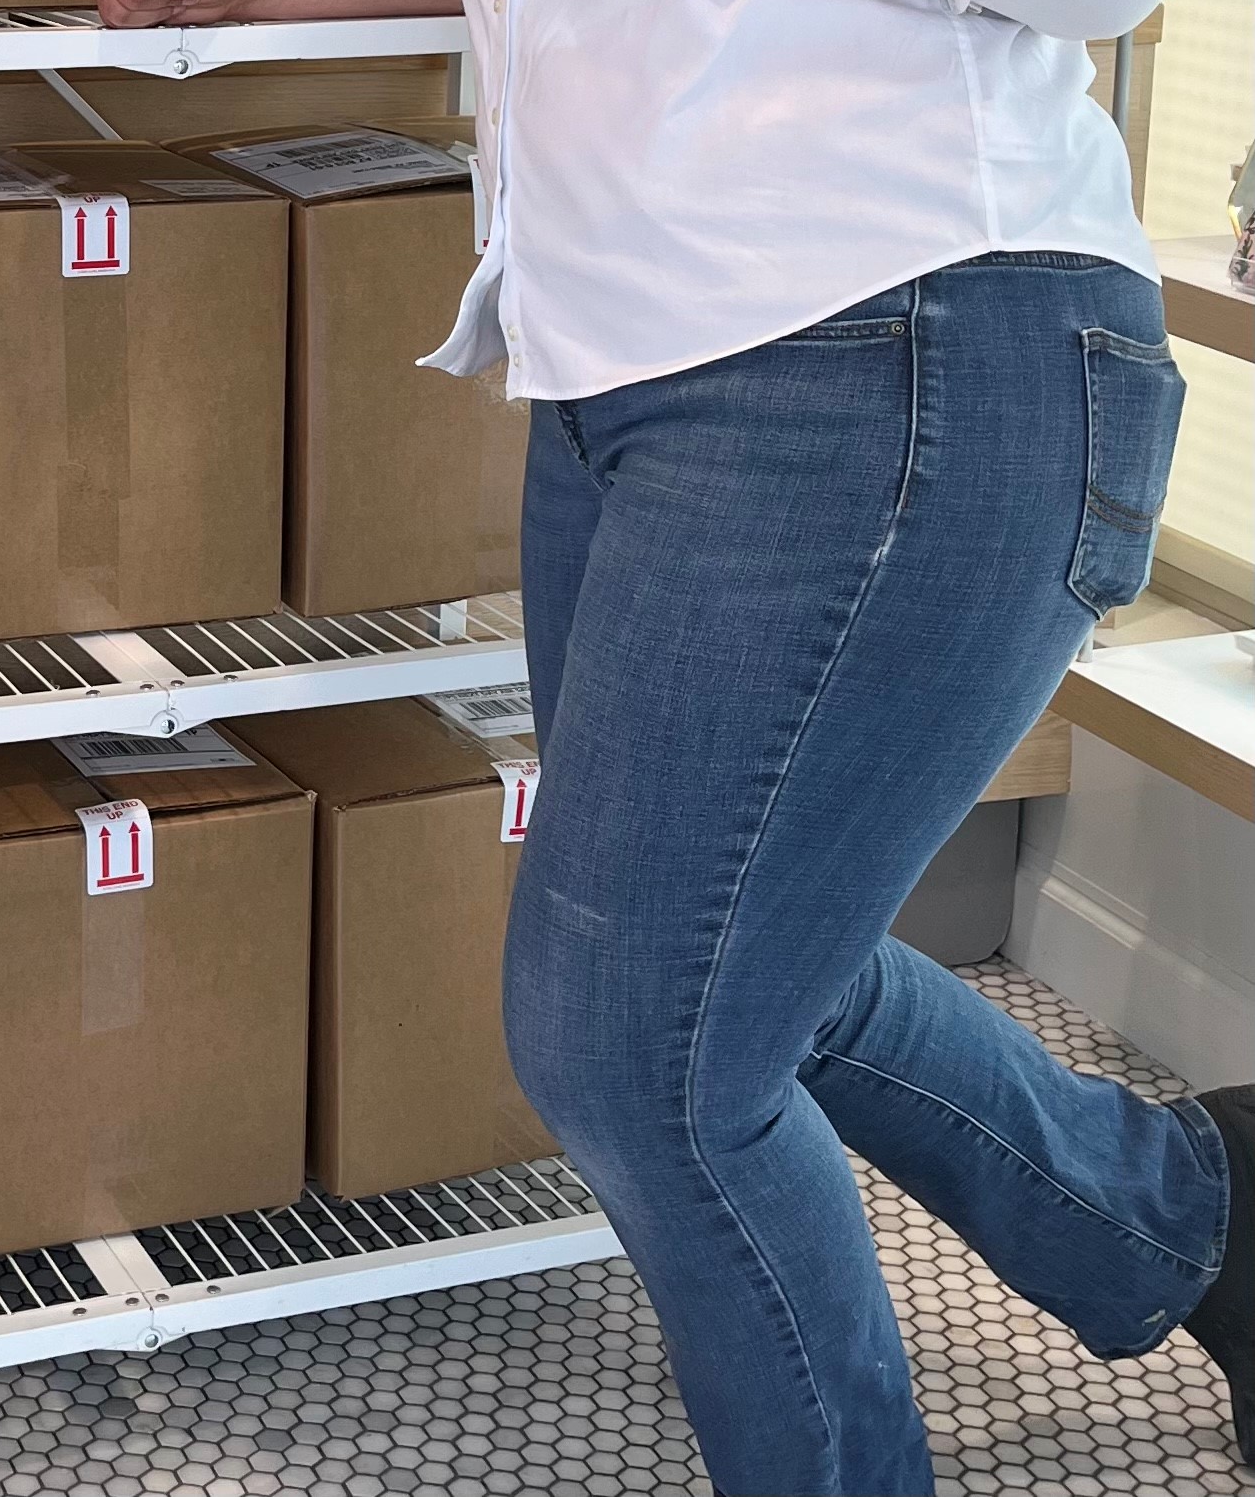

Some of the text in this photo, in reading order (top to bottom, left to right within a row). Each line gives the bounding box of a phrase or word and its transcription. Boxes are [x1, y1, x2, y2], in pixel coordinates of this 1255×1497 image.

[497, 761, 525, 769] THIS
[82, 800, 139, 816] THIS END
[106, 810, 124, 820] UP
